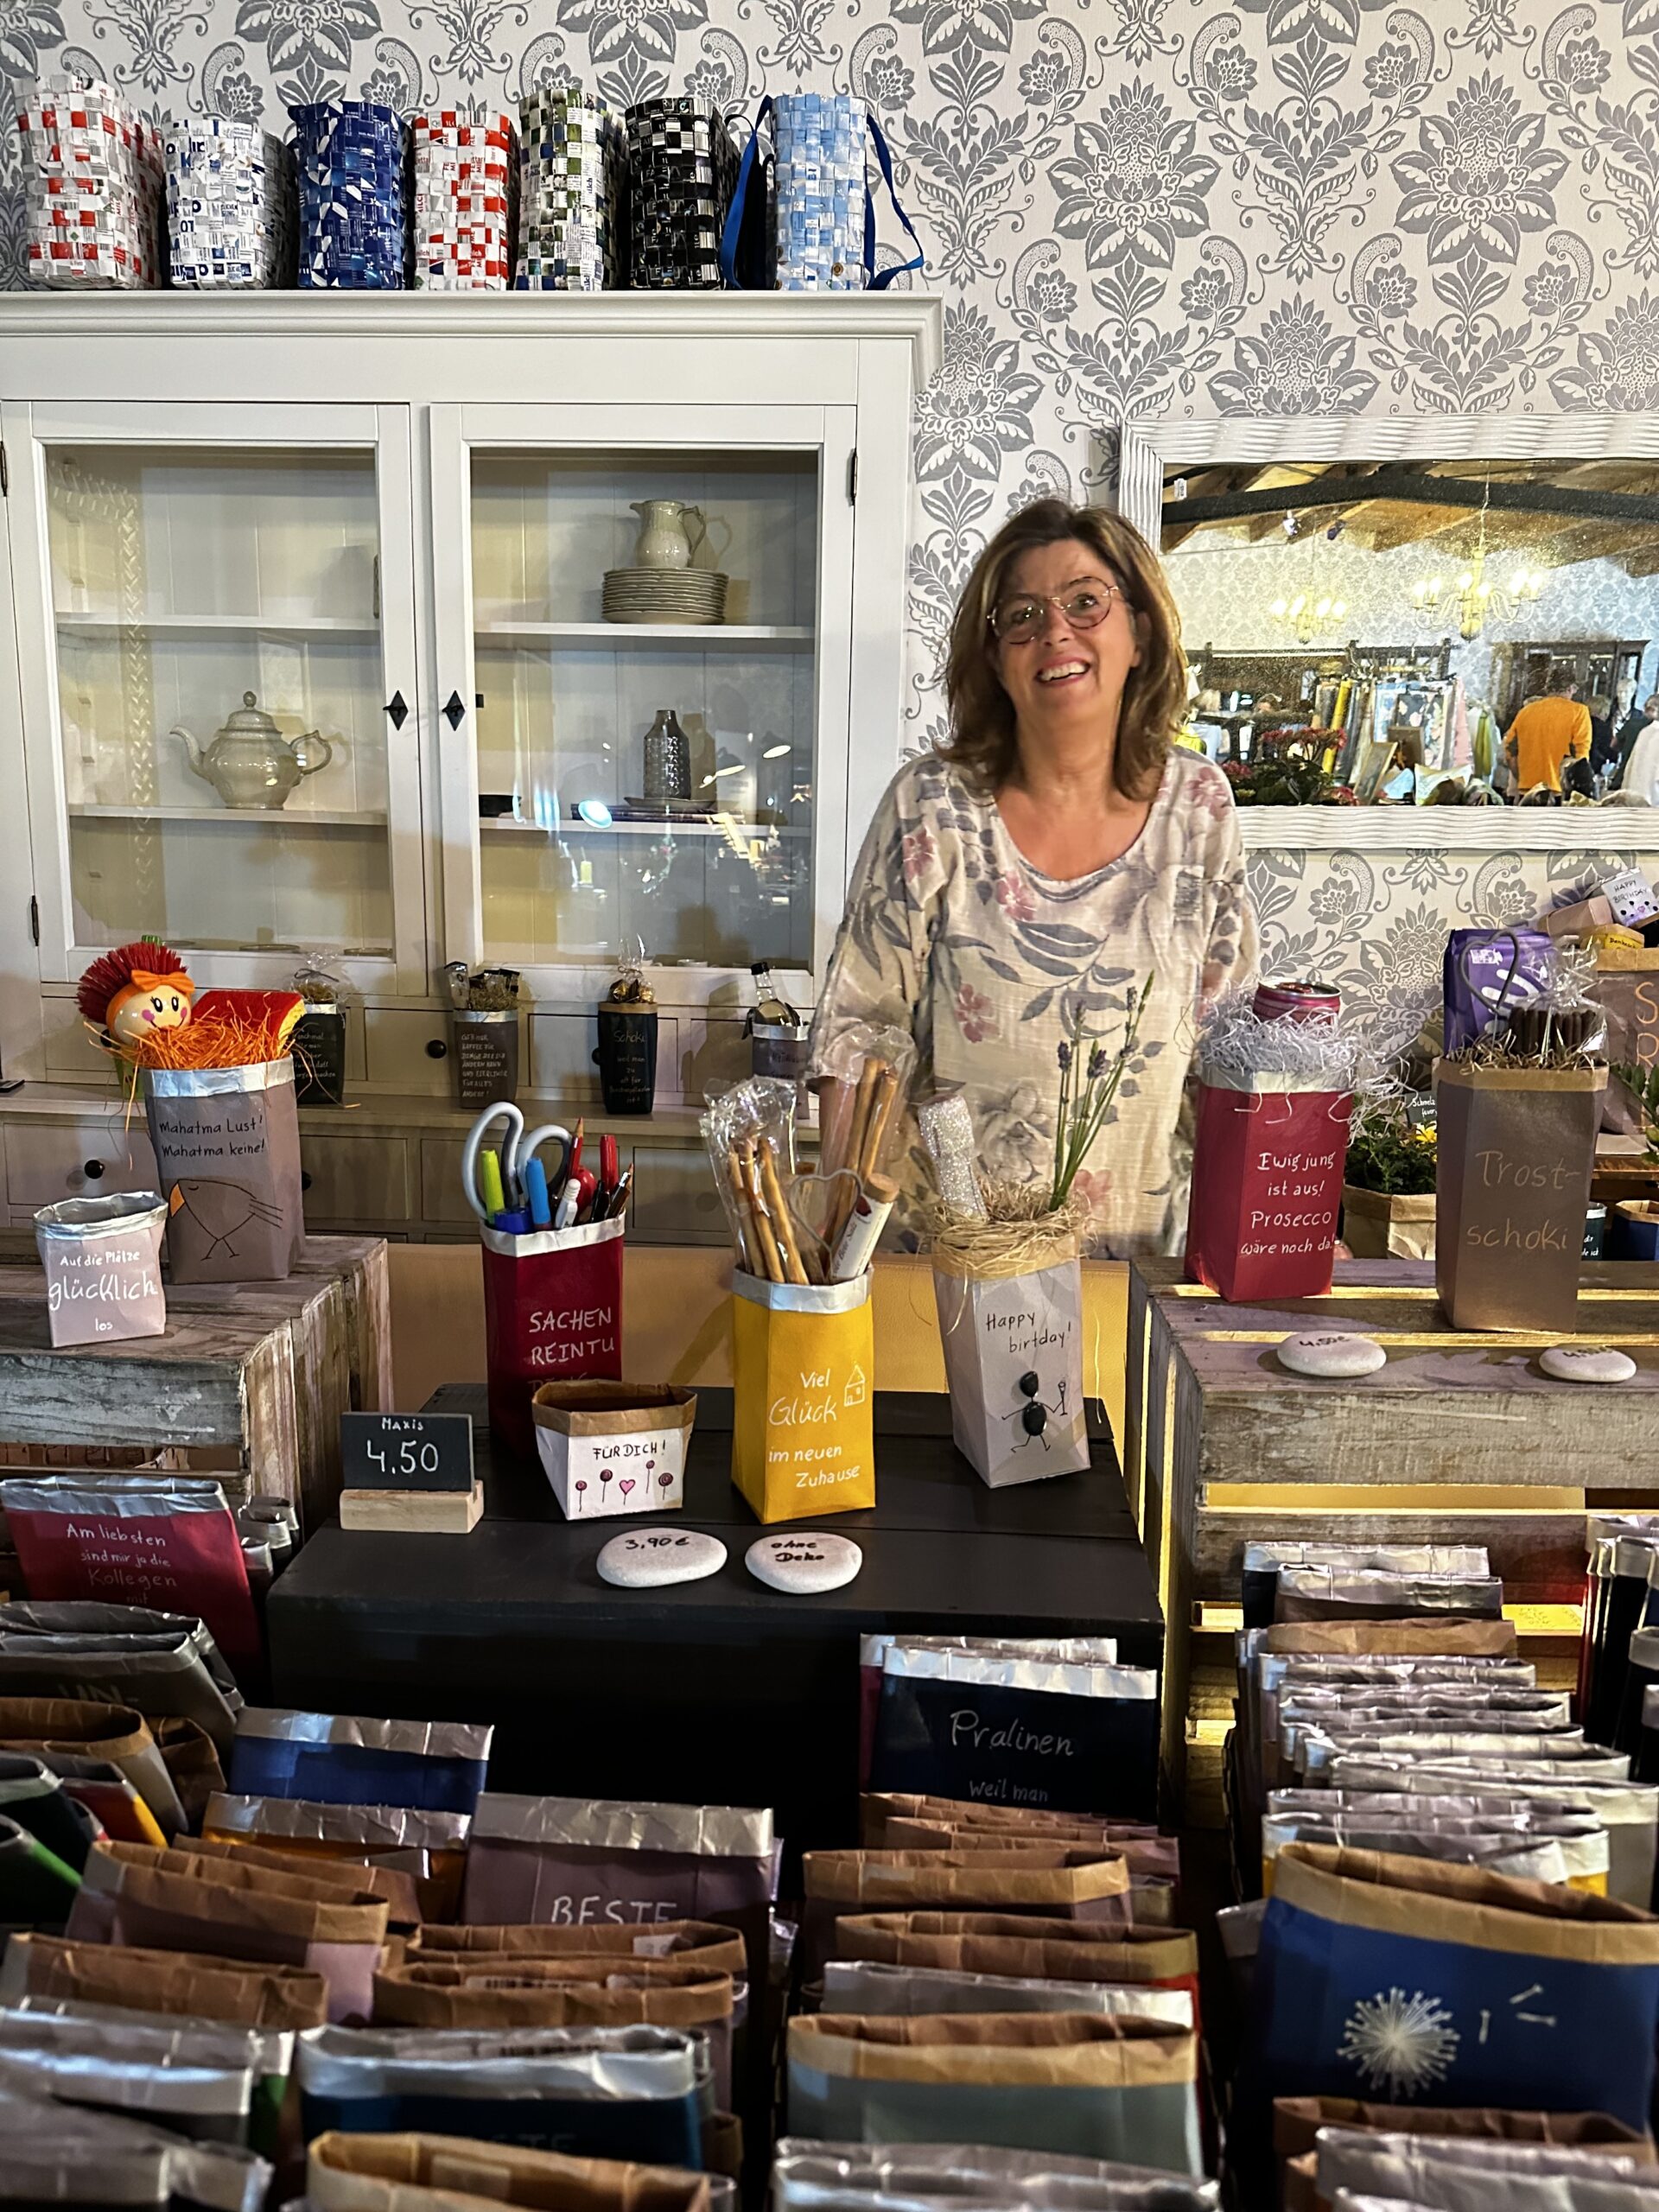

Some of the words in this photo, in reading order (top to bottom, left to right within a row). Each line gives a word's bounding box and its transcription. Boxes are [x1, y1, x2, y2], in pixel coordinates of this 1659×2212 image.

[1612, 887, 1647, 904] BIRTHDAY
[1614, 880, 1637, 893] HAPPY
[159, 1121, 221, 1135] Mahatma
[226, 1115, 263, 1133] Lust!
[162, 1143, 223, 1158] Mahatma
[229, 1138, 264, 1156] keine!
[1257, 1152, 1301, 1173] Ewig
[1301, 1151, 1336, 1172] jung
[1475, 1150, 1581, 1190] Trost-
[1268, 1179, 1287, 1197] ist
[1293, 1179, 1325, 1198] aus!
[1250, 1211, 1332, 1229] Prosecco
[1241, 1239, 1277, 1255] wäre
[1281, 1237, 1313, 1254] noch
[1318, 1232, 1335, 1251] da!
[1467, 1217, 1567, 1250] schoki
[60, 1255, 81, 1268] Auf
[84, 1254, 103, 1267] die
[105, 1249, 140, 1264] Plätze
[48, 1270, 158, 1311] glücklich
[95, 1317, 113, 1332] los
[529, 1306, 612, 1333] SACHEN
[986, 1312, 1035, 1332] Happy
[800, 1368, 830, 1389] Viel
[768, 1395, 837, 1426] Glück
[592, 1445, 620, 1460] FÜR
[768, 1446, 790, 1462] im
[794, 1446, 842, 1462] neuen
[796, 1465, 861, 1488] Zuhause
[67, 1522, 95, 1539] Am
[99, 1523, 166, 1547] liebsten
[771, 1540, 817, 1549] ohne
[80, 1549, 109, 1562] sind
[111, 1553, 130, 1562] mir
[135, 1554, 148, 1568] ja
[150, 1553, 171, 1567] die
[774, 1553, 825, 1562] Deko
[87, 1567, 177, 1591] Kollegen
[950, 1709, 1074, 1756] Pralinen
[969, 1778, 1007, 1799] weil
[1013, 1783, 1048, 1802] man
[551, 1895, 677, 1925] BESTE
